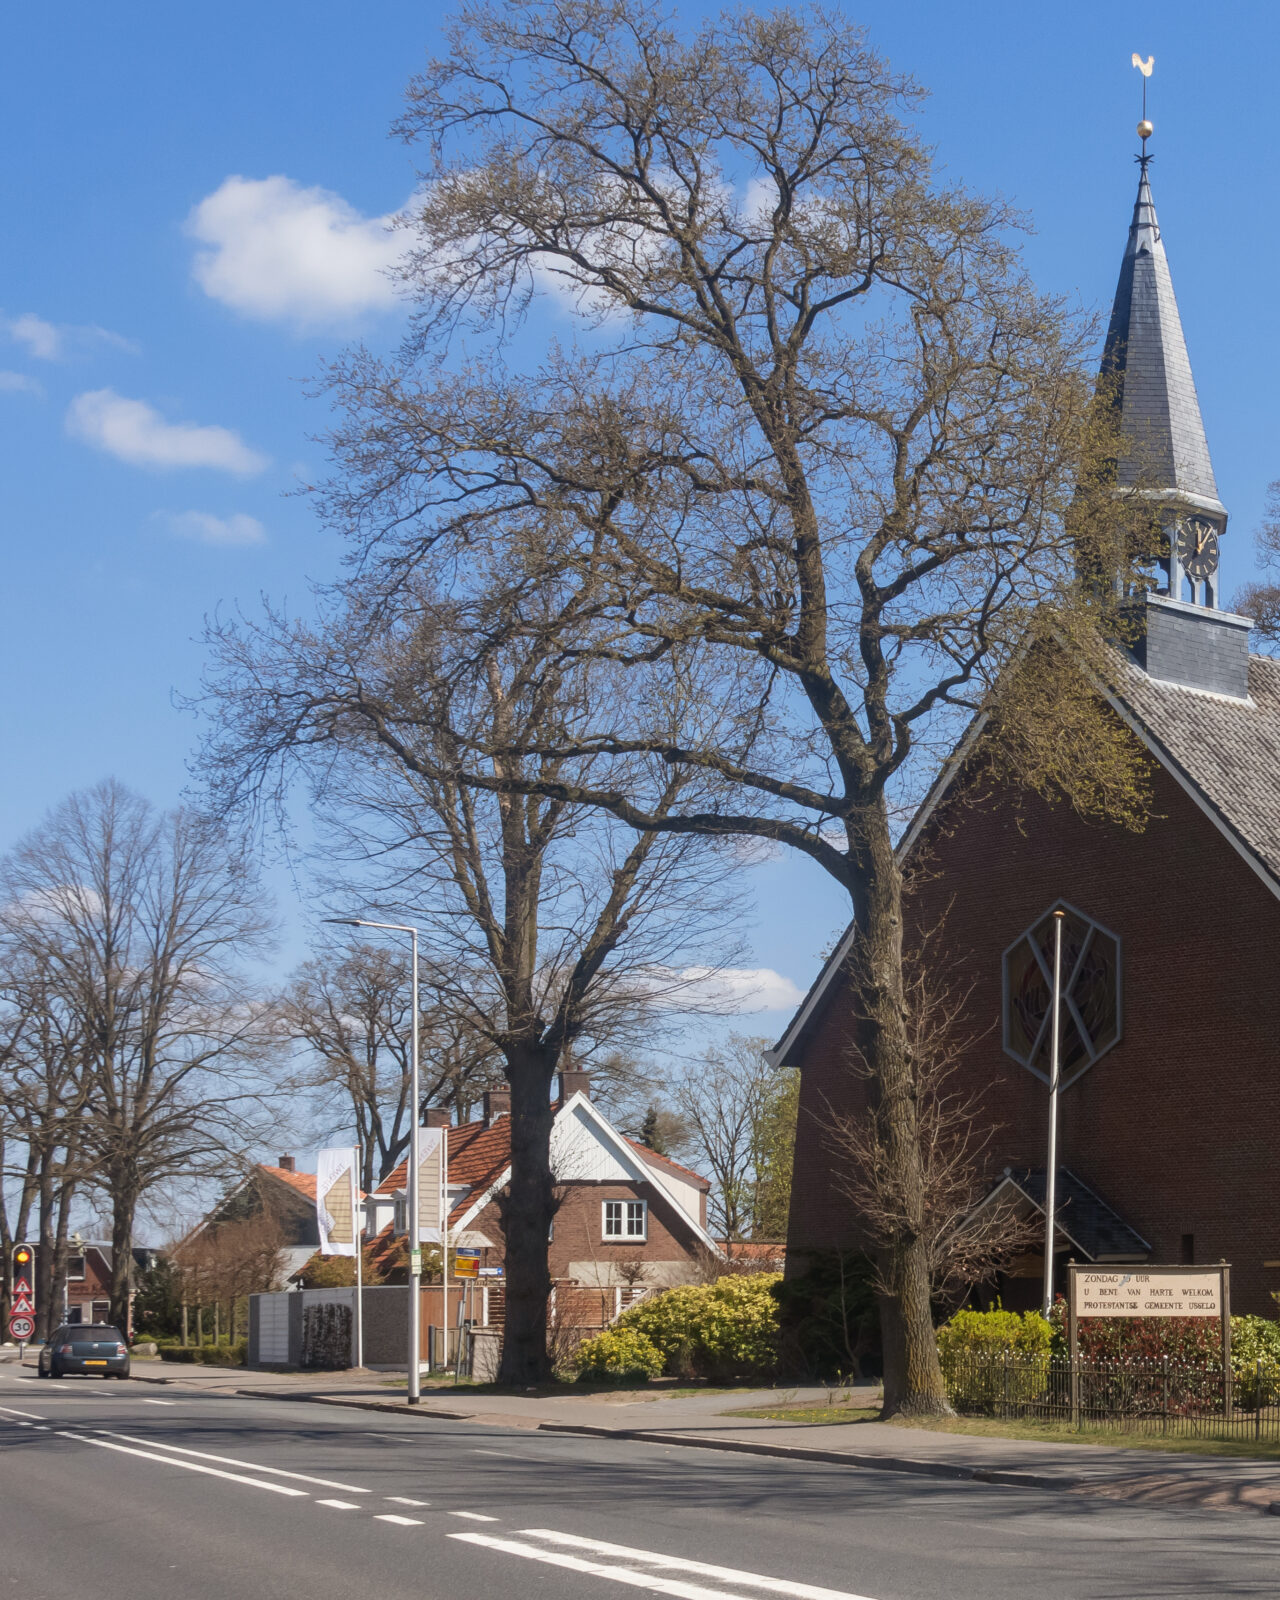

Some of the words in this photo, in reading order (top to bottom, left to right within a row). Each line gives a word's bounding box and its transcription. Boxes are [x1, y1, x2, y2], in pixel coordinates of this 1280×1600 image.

[1084, 1275, 1119, 1283] ZONDAG
[1135, 1275, 1150, 1283] UUR
[1084, 1288, 1090, 1296] U
[1099, 1288, 1118, 1296] BENT
[1127, 1288, 1141, 1296] VAN
[1149, 1288, 1174, 1297] HARTE
[1181, 1288, 1214, 1297] WELKOM
[1144, 1301, 1183, 1310] GEMEENTE
[14, 1322, 30, 1332] 30
